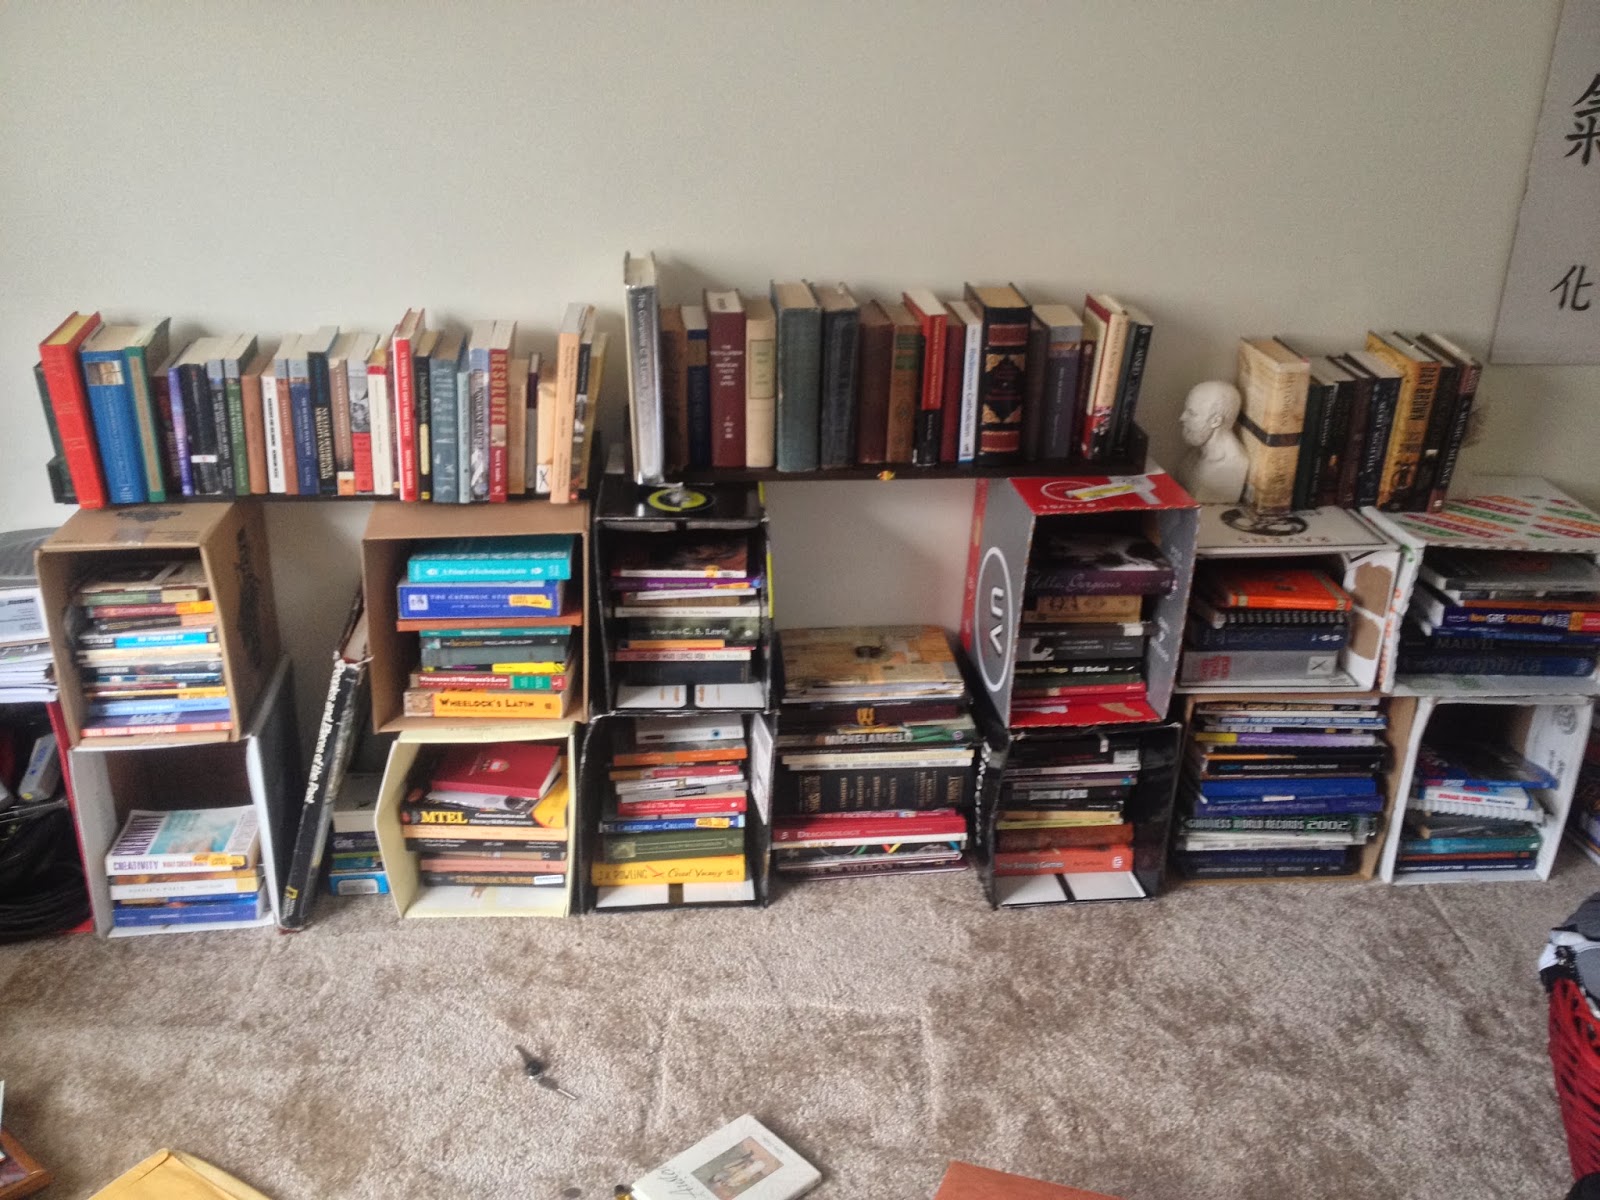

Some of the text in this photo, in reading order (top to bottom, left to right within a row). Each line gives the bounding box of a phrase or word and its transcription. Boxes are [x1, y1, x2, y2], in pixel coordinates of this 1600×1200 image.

[1550, 265, 1594, 312] 化
[491, 353, 506, 421] RESOLUTE
[1410, 366, 1438, 421] DAN BROWN
[964, 392, 973, 438] Catholicism
[1486, 613, 1506, 623] GRE
[439, 698, 535, 708] WHEELOCK'S LATIN
[824, 732, 914, 745] MICHELANGELO
[421, 811, 468, 824] MTEL
[1187, 819, 1349, 830] GUINNESS WORLD RECORDS 2002
[113, 860, 159, 871] CREATIVITY
